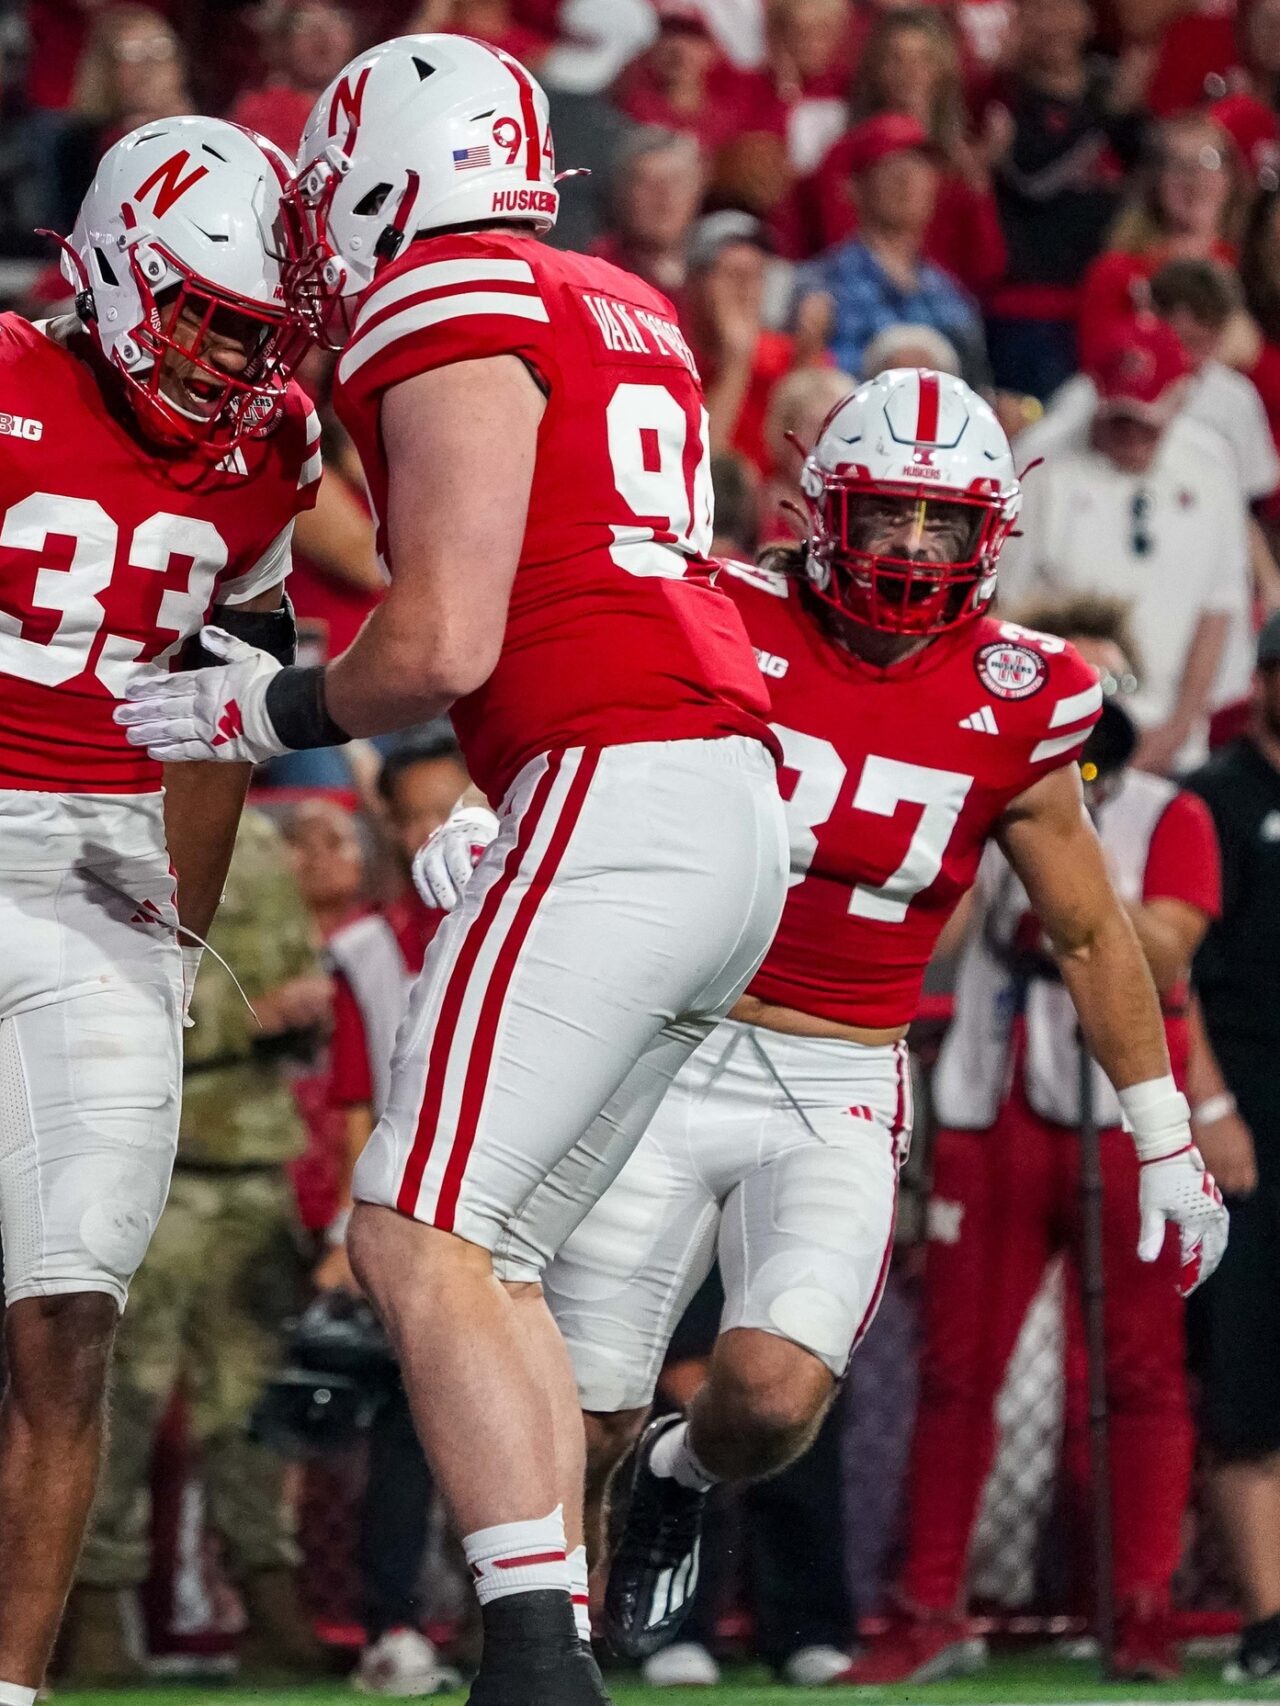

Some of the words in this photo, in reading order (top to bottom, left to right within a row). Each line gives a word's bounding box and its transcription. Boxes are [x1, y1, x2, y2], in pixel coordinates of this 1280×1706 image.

[328, 67, 372, 138] N
[133, 149, 210, 219] N
[582, 294, 651, 354] VAN
